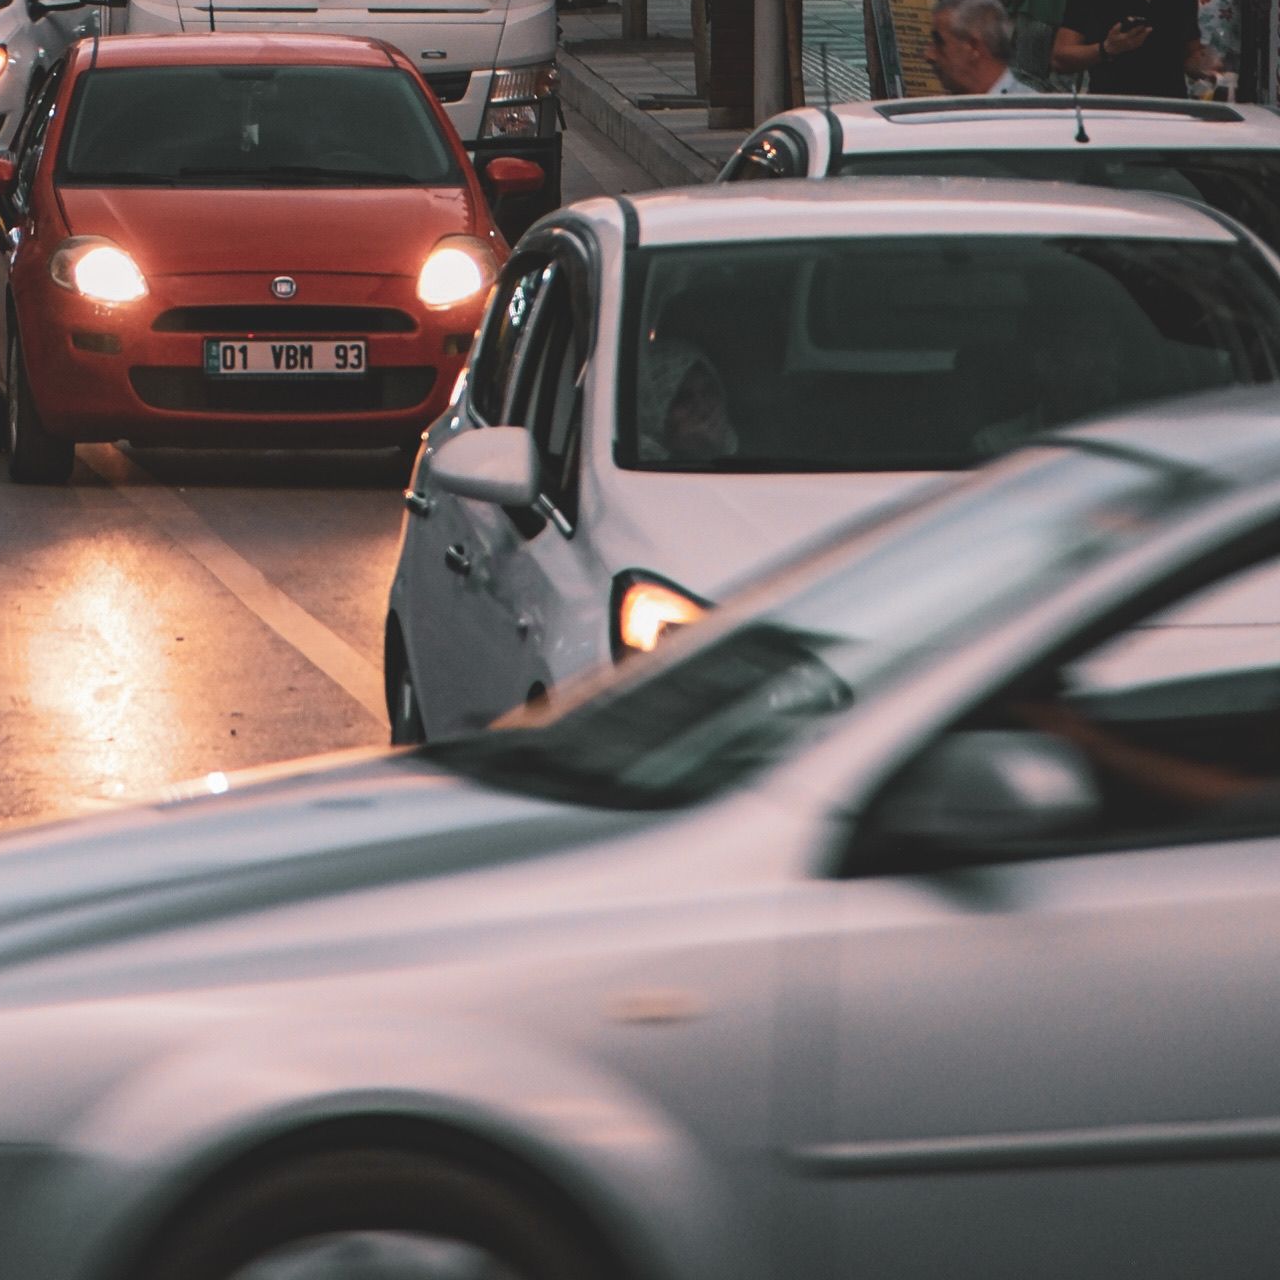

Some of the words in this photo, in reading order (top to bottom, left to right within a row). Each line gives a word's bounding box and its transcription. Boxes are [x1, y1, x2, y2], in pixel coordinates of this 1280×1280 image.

[222, 344, 248, 370] 01
[271, 344, 314, 370] VBM
[335, 343, 363, 370] 93
